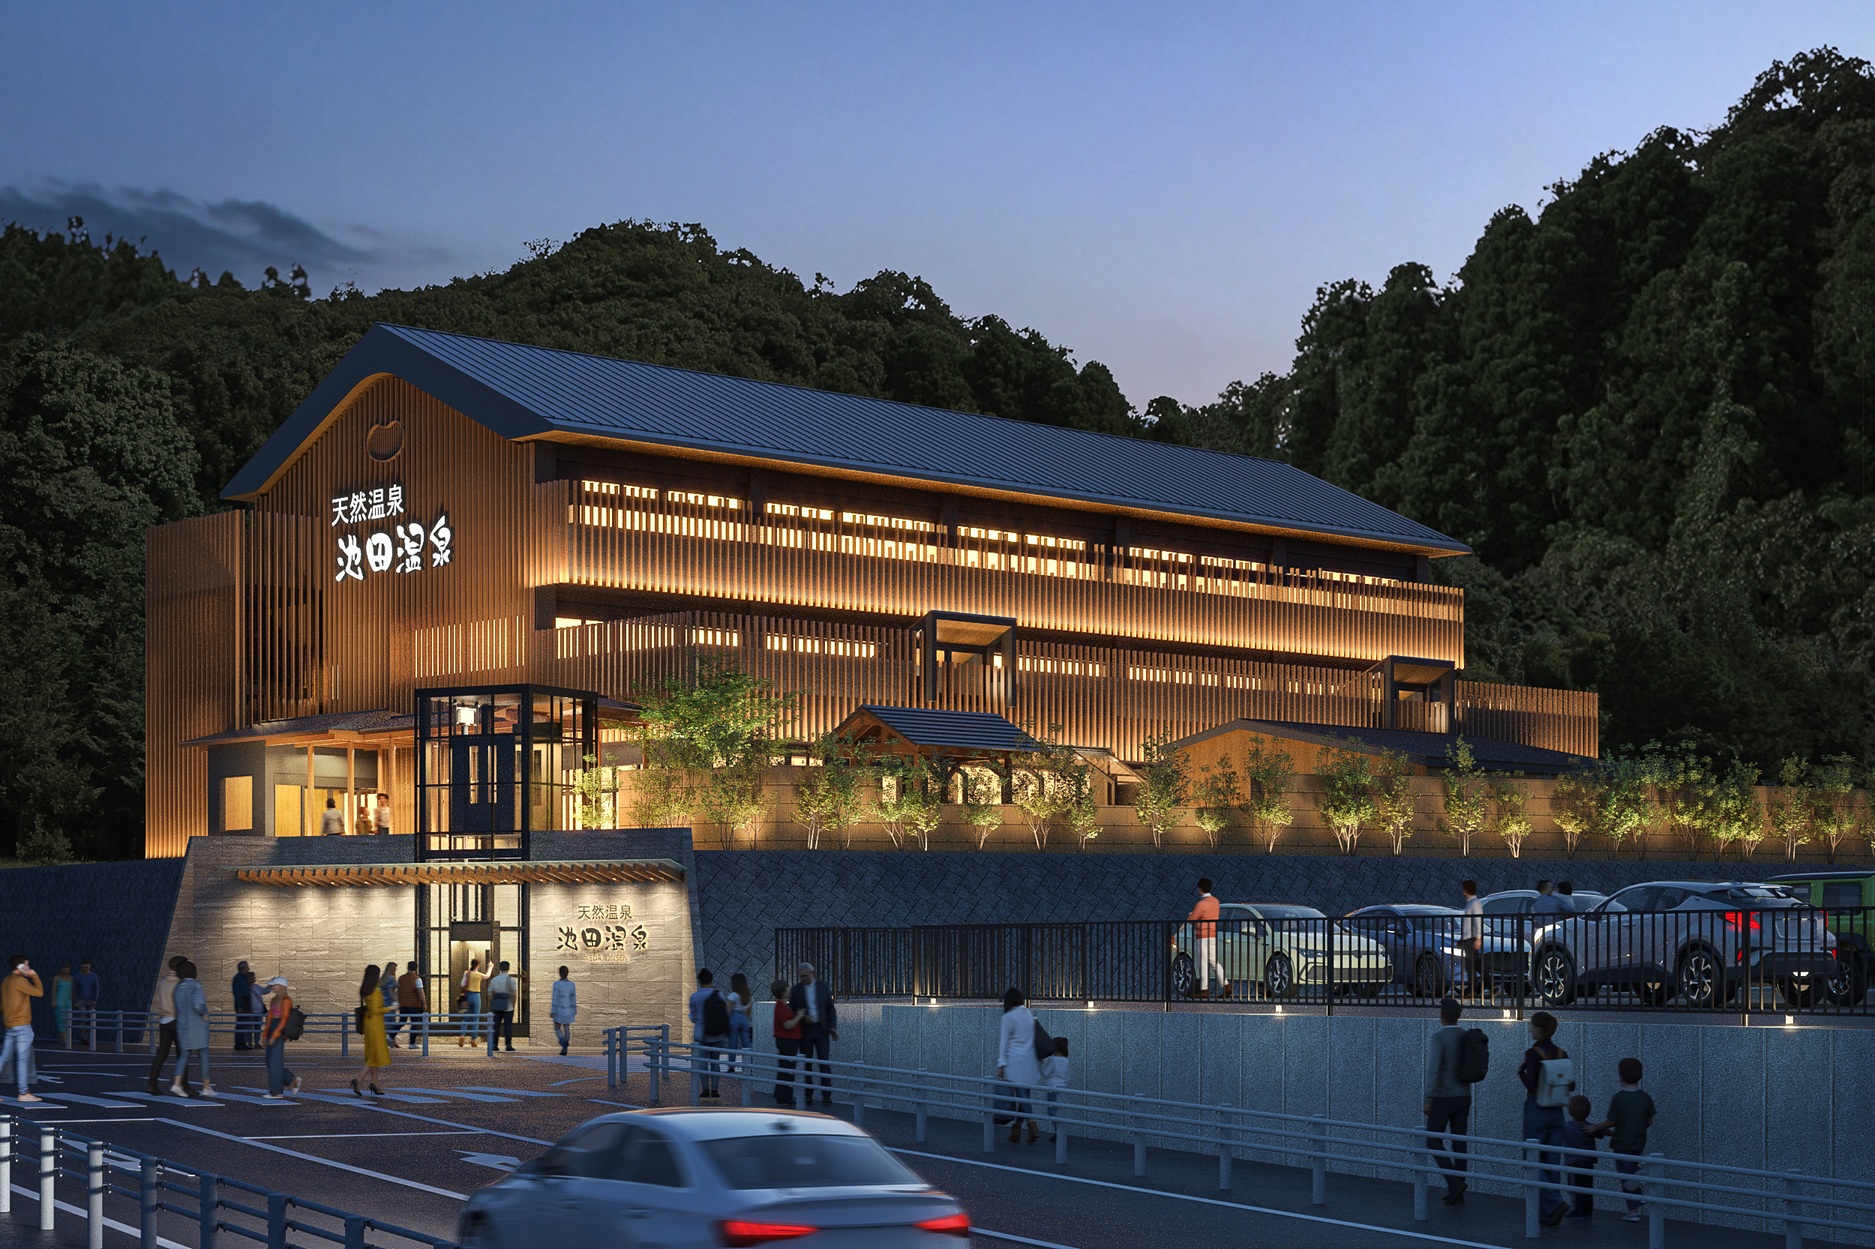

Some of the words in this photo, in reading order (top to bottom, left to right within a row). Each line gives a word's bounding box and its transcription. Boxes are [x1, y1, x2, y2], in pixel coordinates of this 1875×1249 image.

[331, 484, 404, 527] 天然温泉
[335, 515, 451, 582] 池田温泉
[578, 904, 632, 919] 天然温泉
[556, 925, 647, 951] 池田温泉
